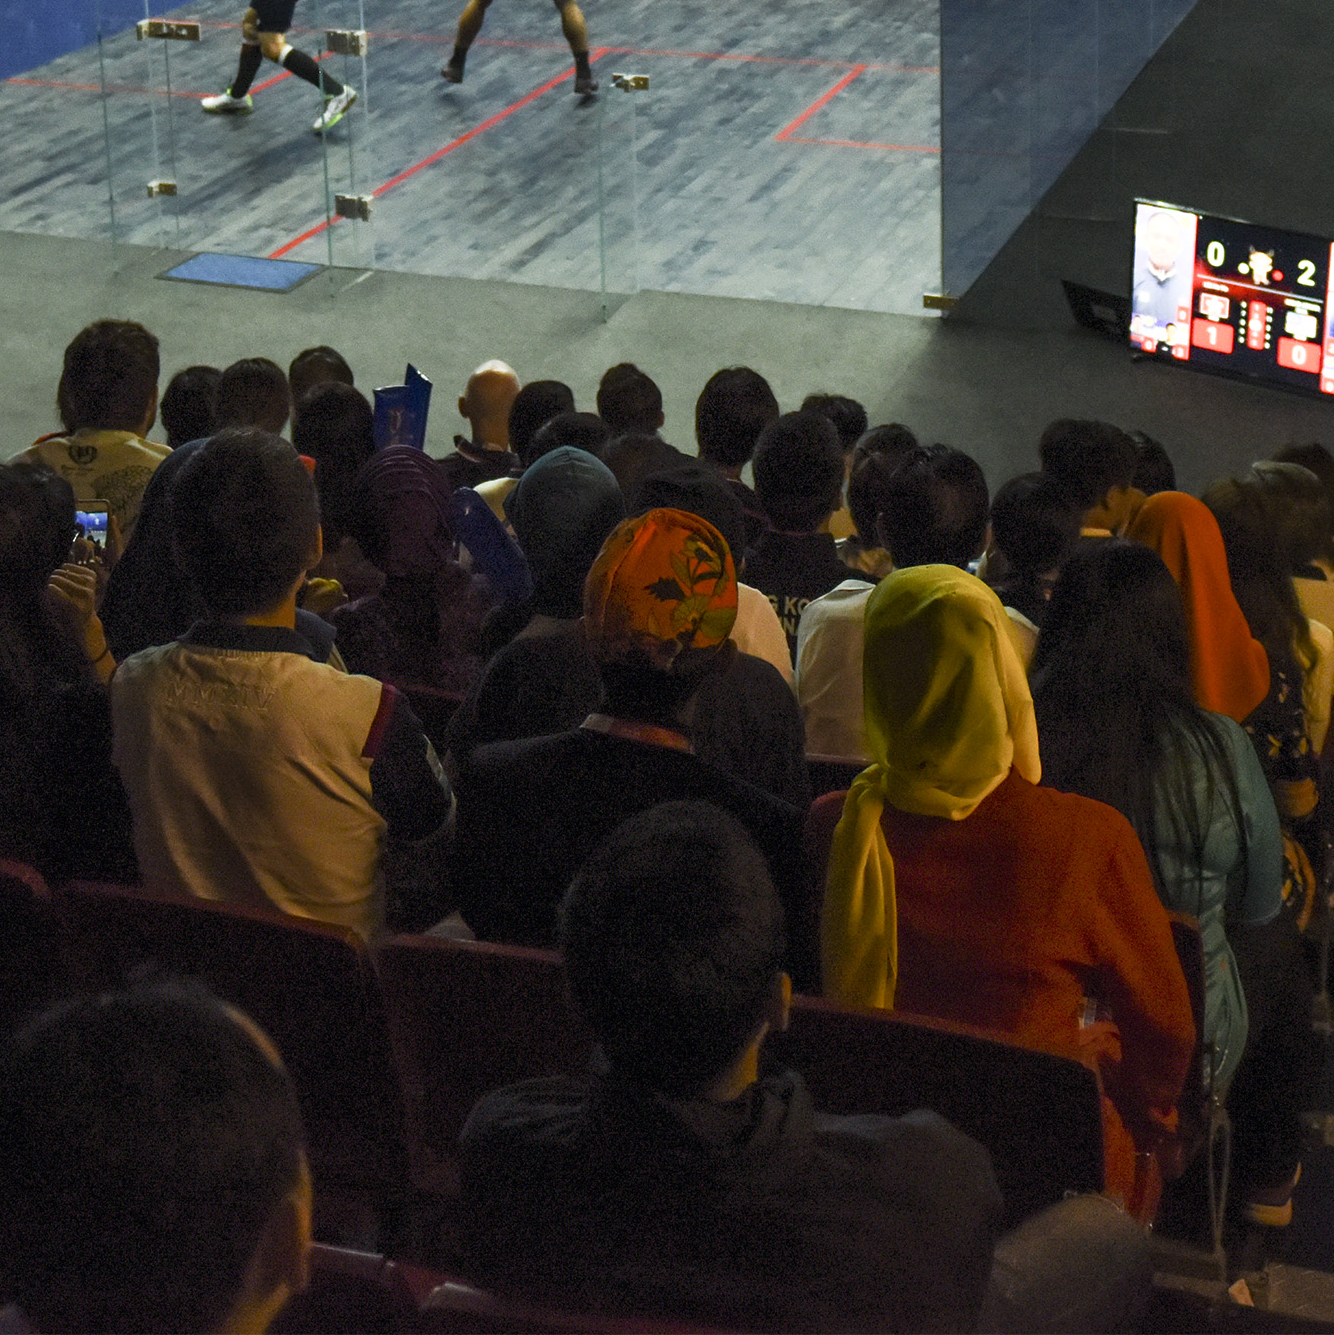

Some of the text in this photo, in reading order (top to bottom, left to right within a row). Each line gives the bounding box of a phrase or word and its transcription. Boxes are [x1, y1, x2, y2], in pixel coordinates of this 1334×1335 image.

[1206, 240, 1226, 268] 0
[1296, 259, 1316, 287] 2
[1206, 326, 1217, 346] 1
[1291, 345, 1307, 365] 0
